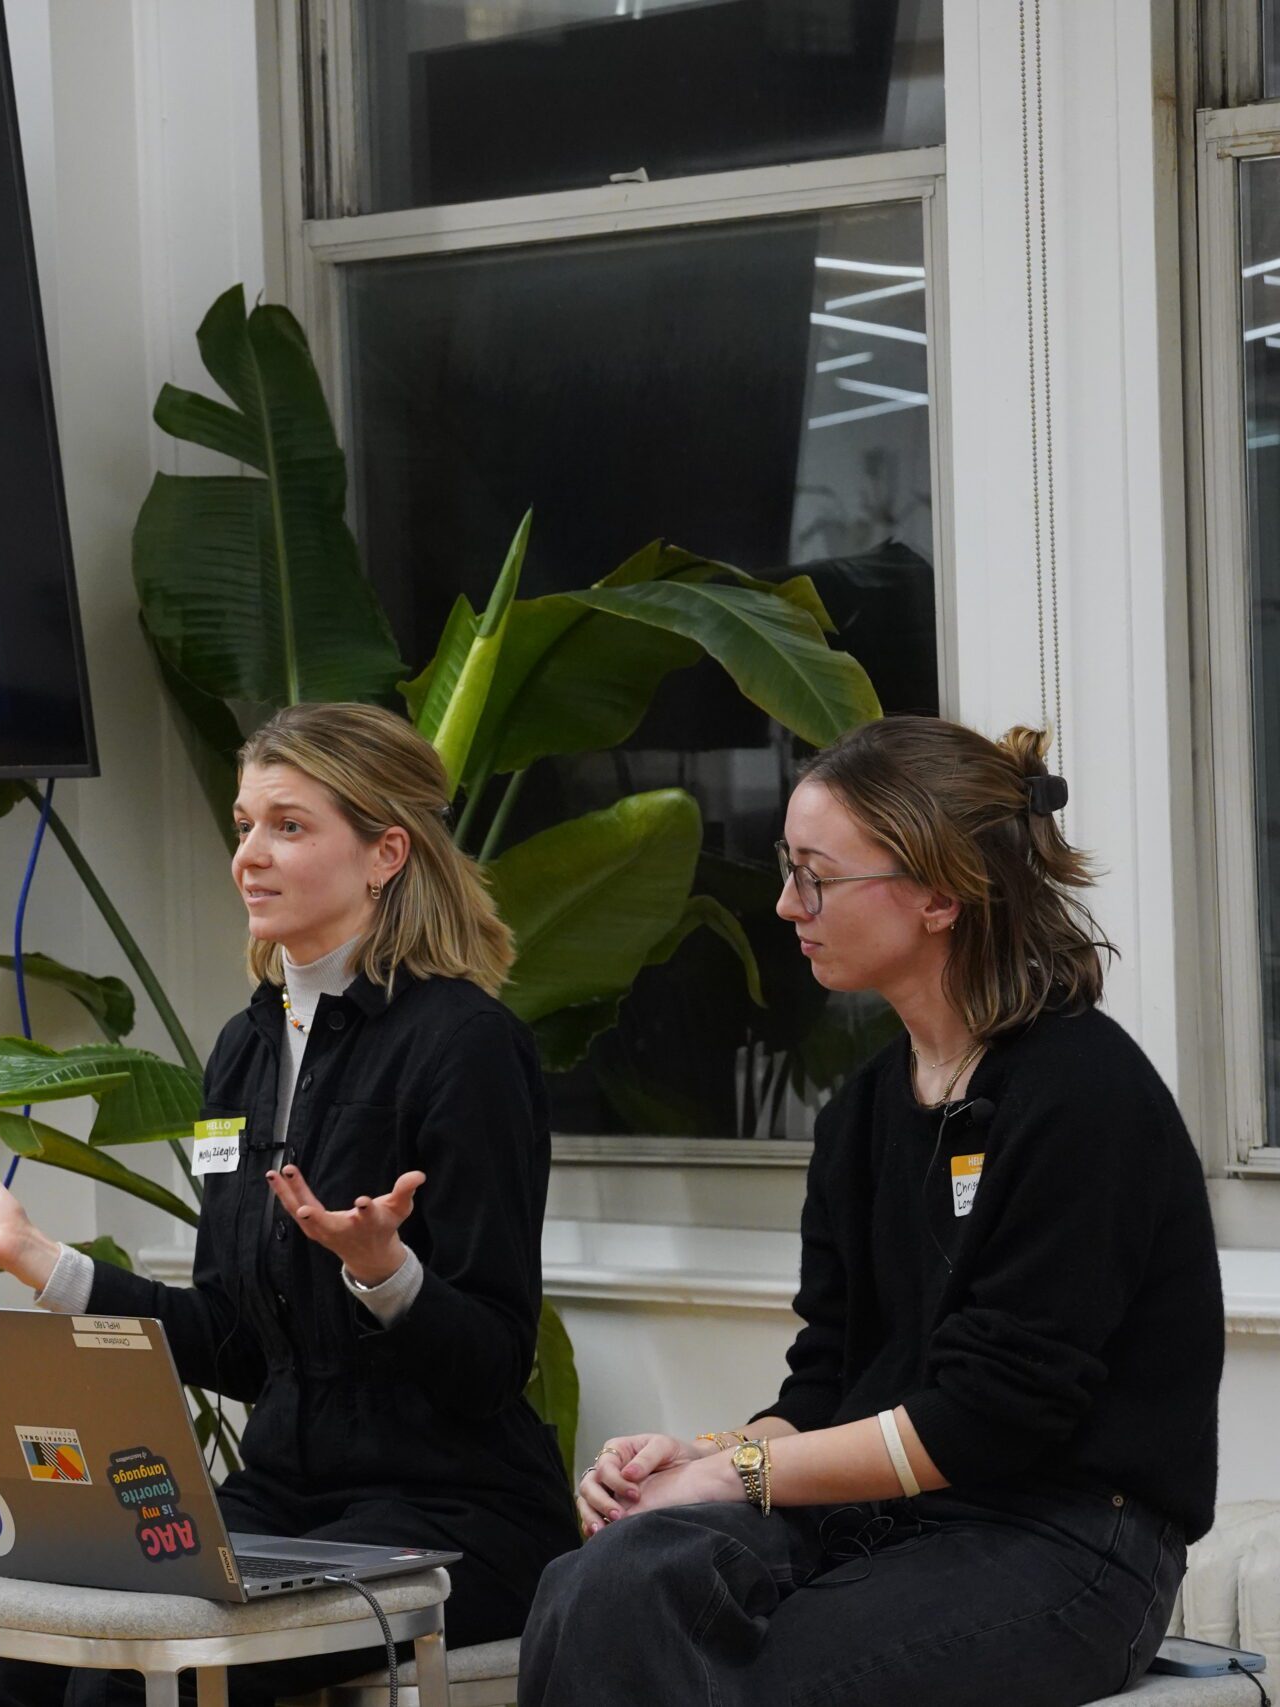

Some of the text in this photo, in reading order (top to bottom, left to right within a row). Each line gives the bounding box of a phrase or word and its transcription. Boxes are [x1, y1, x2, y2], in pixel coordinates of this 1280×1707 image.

[206, 1120, 231, 1130] HELLO
[212, 1146, 238, 1162] Ziegler
[19, 1433, 78, 1443] OCCUPATIONAL
[112, 1463, 167, 1484] language
[121, 1478, 175, 1504] favorite
[141, 1504, 174, 1520] is my
[140, 1519, 196, 1557] AAC
[221, 1550, 234, 1581] Lenovo
